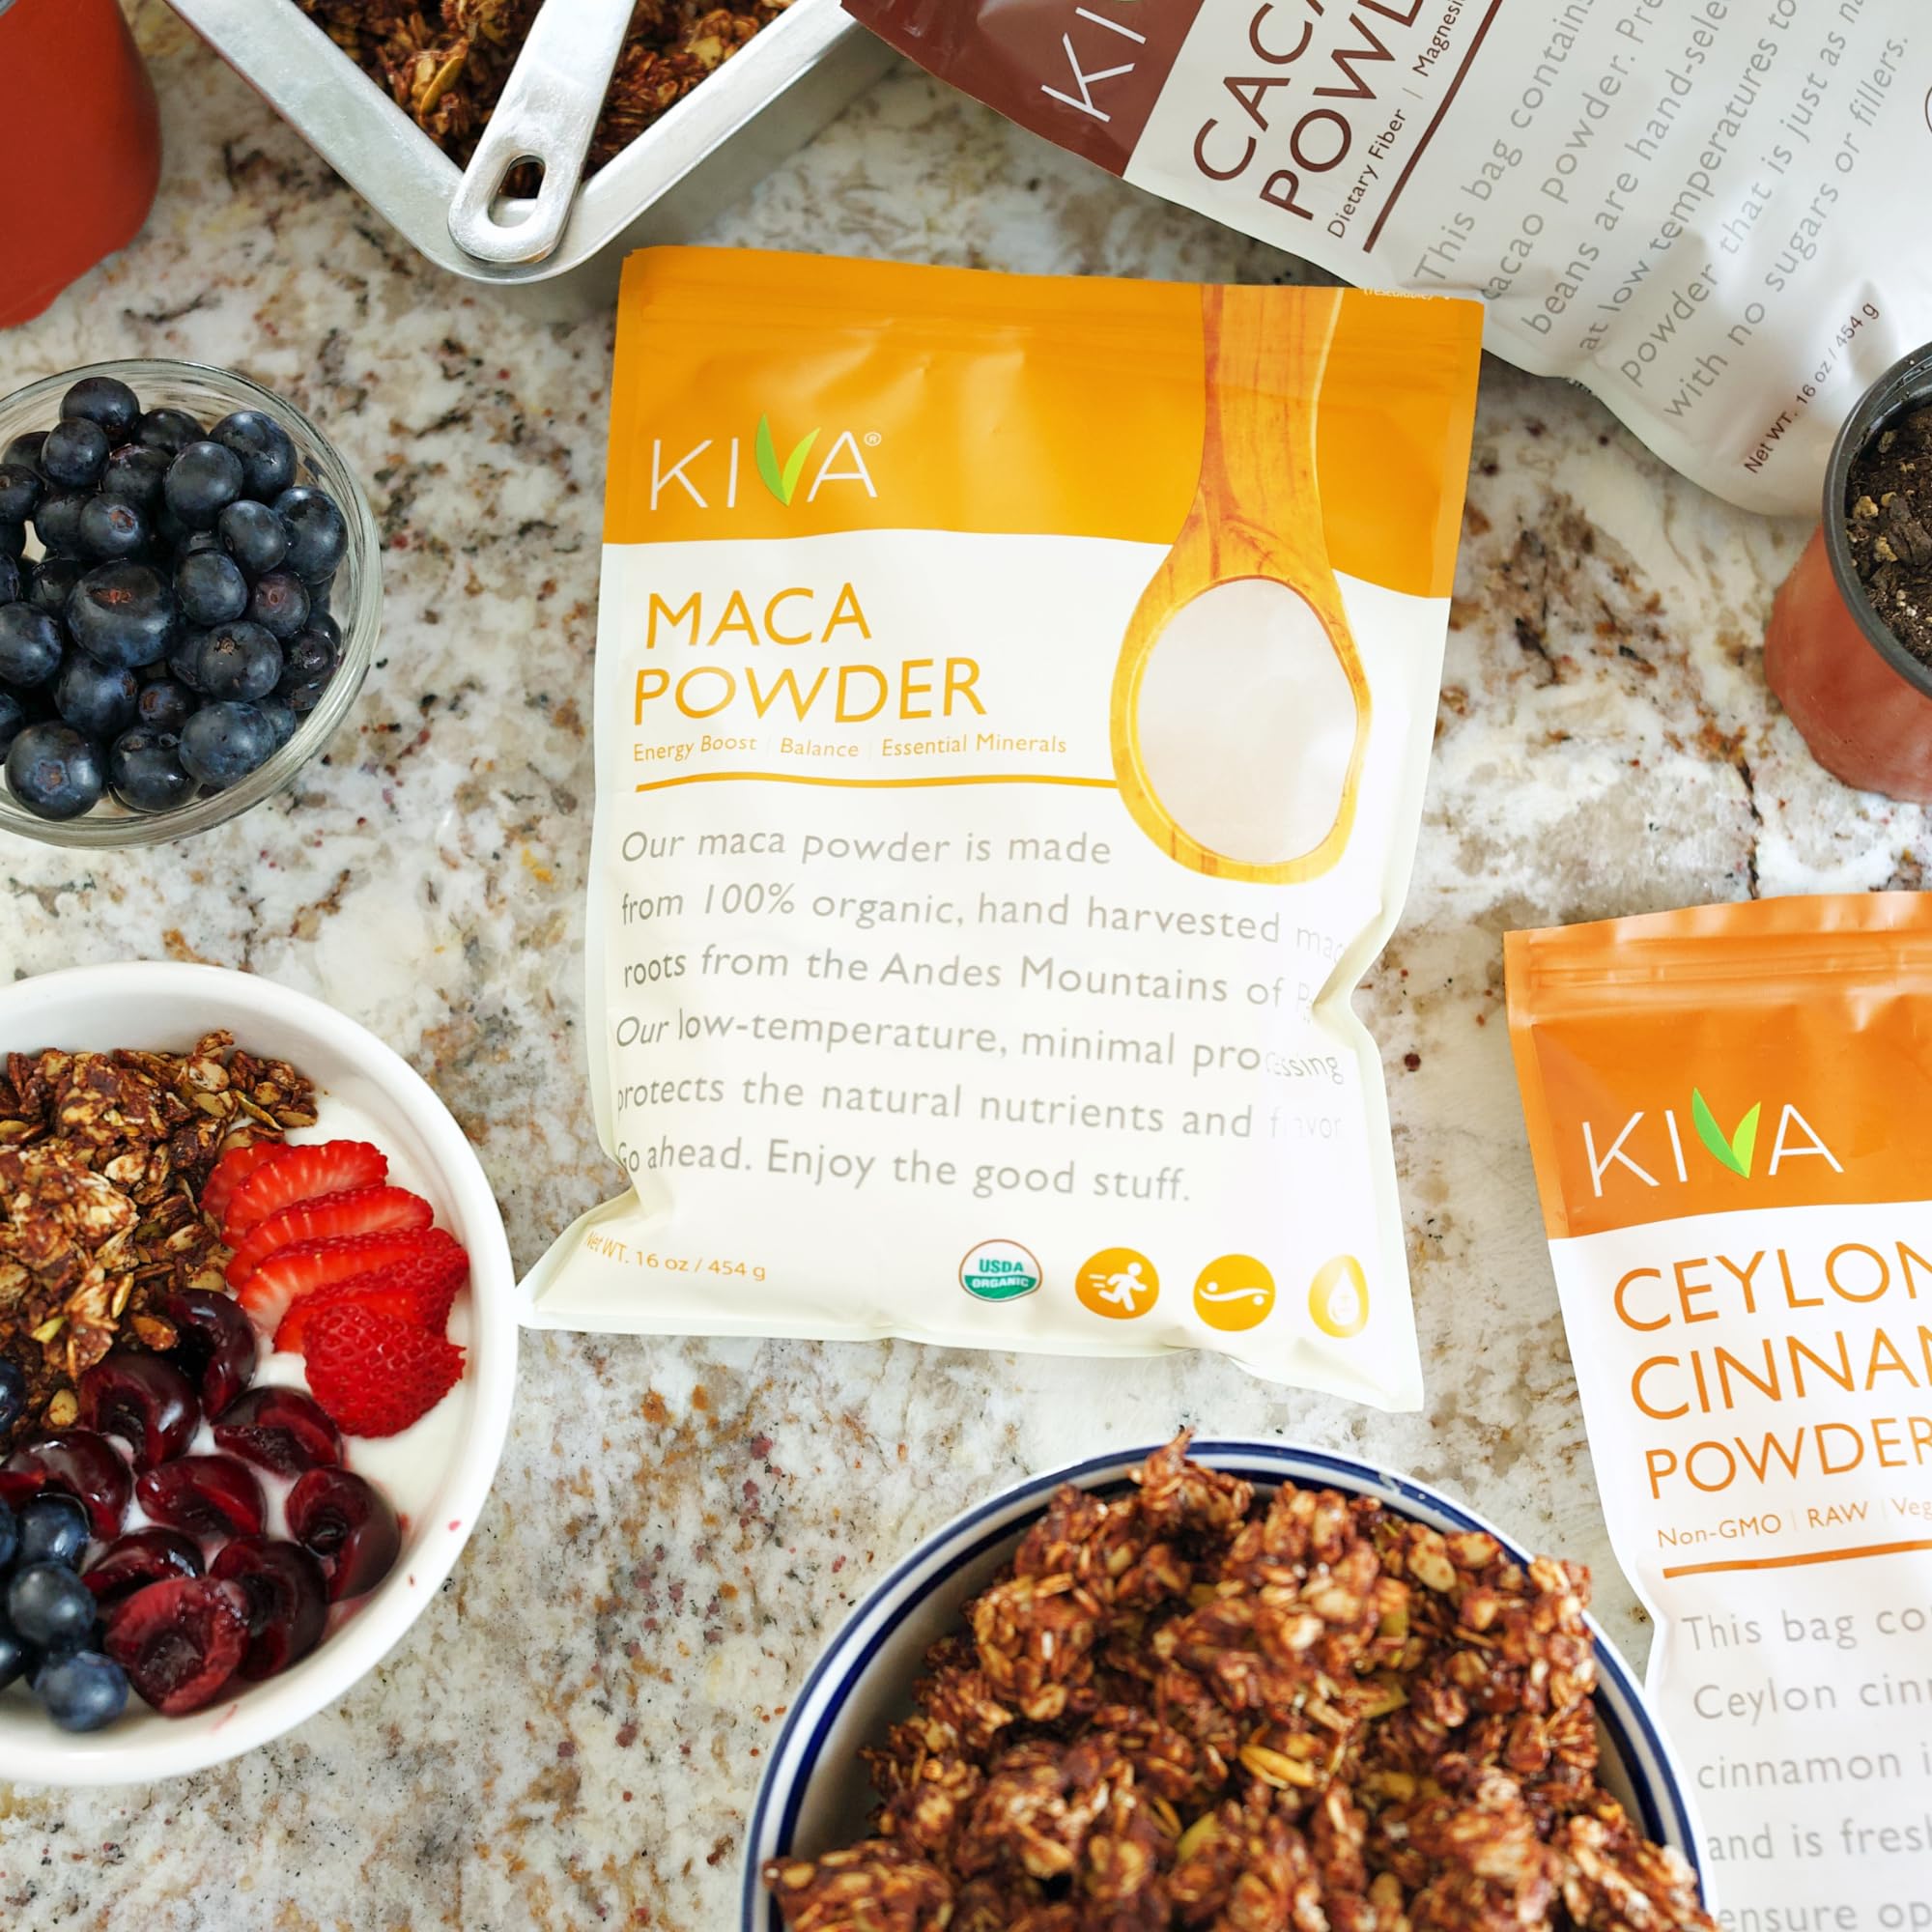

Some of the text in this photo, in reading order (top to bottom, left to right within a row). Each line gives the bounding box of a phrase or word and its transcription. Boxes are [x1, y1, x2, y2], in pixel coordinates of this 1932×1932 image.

[1041, 0, 1147, 123] KI
[1193, 0, 1324, 181] CAC
[1327, 0, 1465, 239] Dietary Fiber Magnesi
[1413, 0, 1594, 286] This bag contain
[1480, 213, 1544, 301] cacao
[1541, 55, 1636, 204] powder.
[1579, 323, 1607, 352] at
[1599, 259, 1652, 313] low
[1649, 36, 1778, 253] temperatures
[1620, 263, 1719, 389] powder
[1719, 181, 1774, 256] that
[1761, 145, 1793, 176] is
[1780, 72, 1828, 143] just
[1820, 31, 1846, 67] as
[1521, 241, 1600, 335] beans
[1595, 174, 1639, 233] are
[1662, 38, 1908, 419] with no sugars or fillers.
[1744, 443, 1774, 473] Net
[1766, 411, 1799, 441] WT.
[1796, 384, 1816, 405] 16
[1814, 360, 1833, 384] oz
[1836, 315, 1863, 349] 454
[1862, 302, 1880, 320] g
[646, 582, 871, 649] MACA
[635, 657, 987, 725] POWDER
[634, 733, 1067, 762] Energy Boost Balance Essential Minerals
[621, 831, 1111, 865] Our maca powder is made
[622, 893, 684, 925] from
[704, 883, 796, 916] 100%
[812, 894, 964, 928] organic,
[979, 893, 1068, 926] hand
[1088, 896, 1280, 943] harvested
[625, 949, 686, 987] roots
[702, 945, 788, 976] from
[807, 949, 867, 981] the
[880, 952, 1001, 987] Andes
[1021, 956, 1227, 1002] Mountains
[1247, 977, 1286, 1008] of
[616, 1016, 669, 1047] Our
[679, 1008, 1007, 1058] low-temperature,
[1022, 1028, 1175, 1065] minimal
[618, 1077, 724, 1122] protects
[743, 1071, 804, 1106] the
[822, 1084, 961, 1119] natural
[980, 1094, 1164, 1132] nutrients
[1182, 1104, 1252, 1138] and
[647, 1135, 752, 1171] ahead.
[767, 1138, 874, 1189] Enjoy
[894, 1149, 956, 1185] the
[973, 1159, 1075, 1199] good
[1094, 1166, 1190, 1203] stuff.
[1582, 1087, 1844, 1198] KIVA
[637, 1251, 659, 1267] 16
[665, 1259, 689, 1271] oz
[708, 1260, 747, 1276] 454
[753, 1266, 766, 1281] g
[972, 1277, 1029, 1289] ORGANIC
[979, 1259, 1024, 1273] USDA
[1631, 1325, 1932, 1420] CINNA
[1658, 1514, 1782, 1548] Non-GMO
[1807, 1501, 1869, 1529] RAW
[1682, 1604, 1932, 1650] This bag co
[1693, 1673, 1932, 1726] Ceylon cin
[1697, 1753, 1901, 1789] cinnamon
[1707, 1822, 1774, 1861] and
[1791, 1824, 1823, 1858] is
